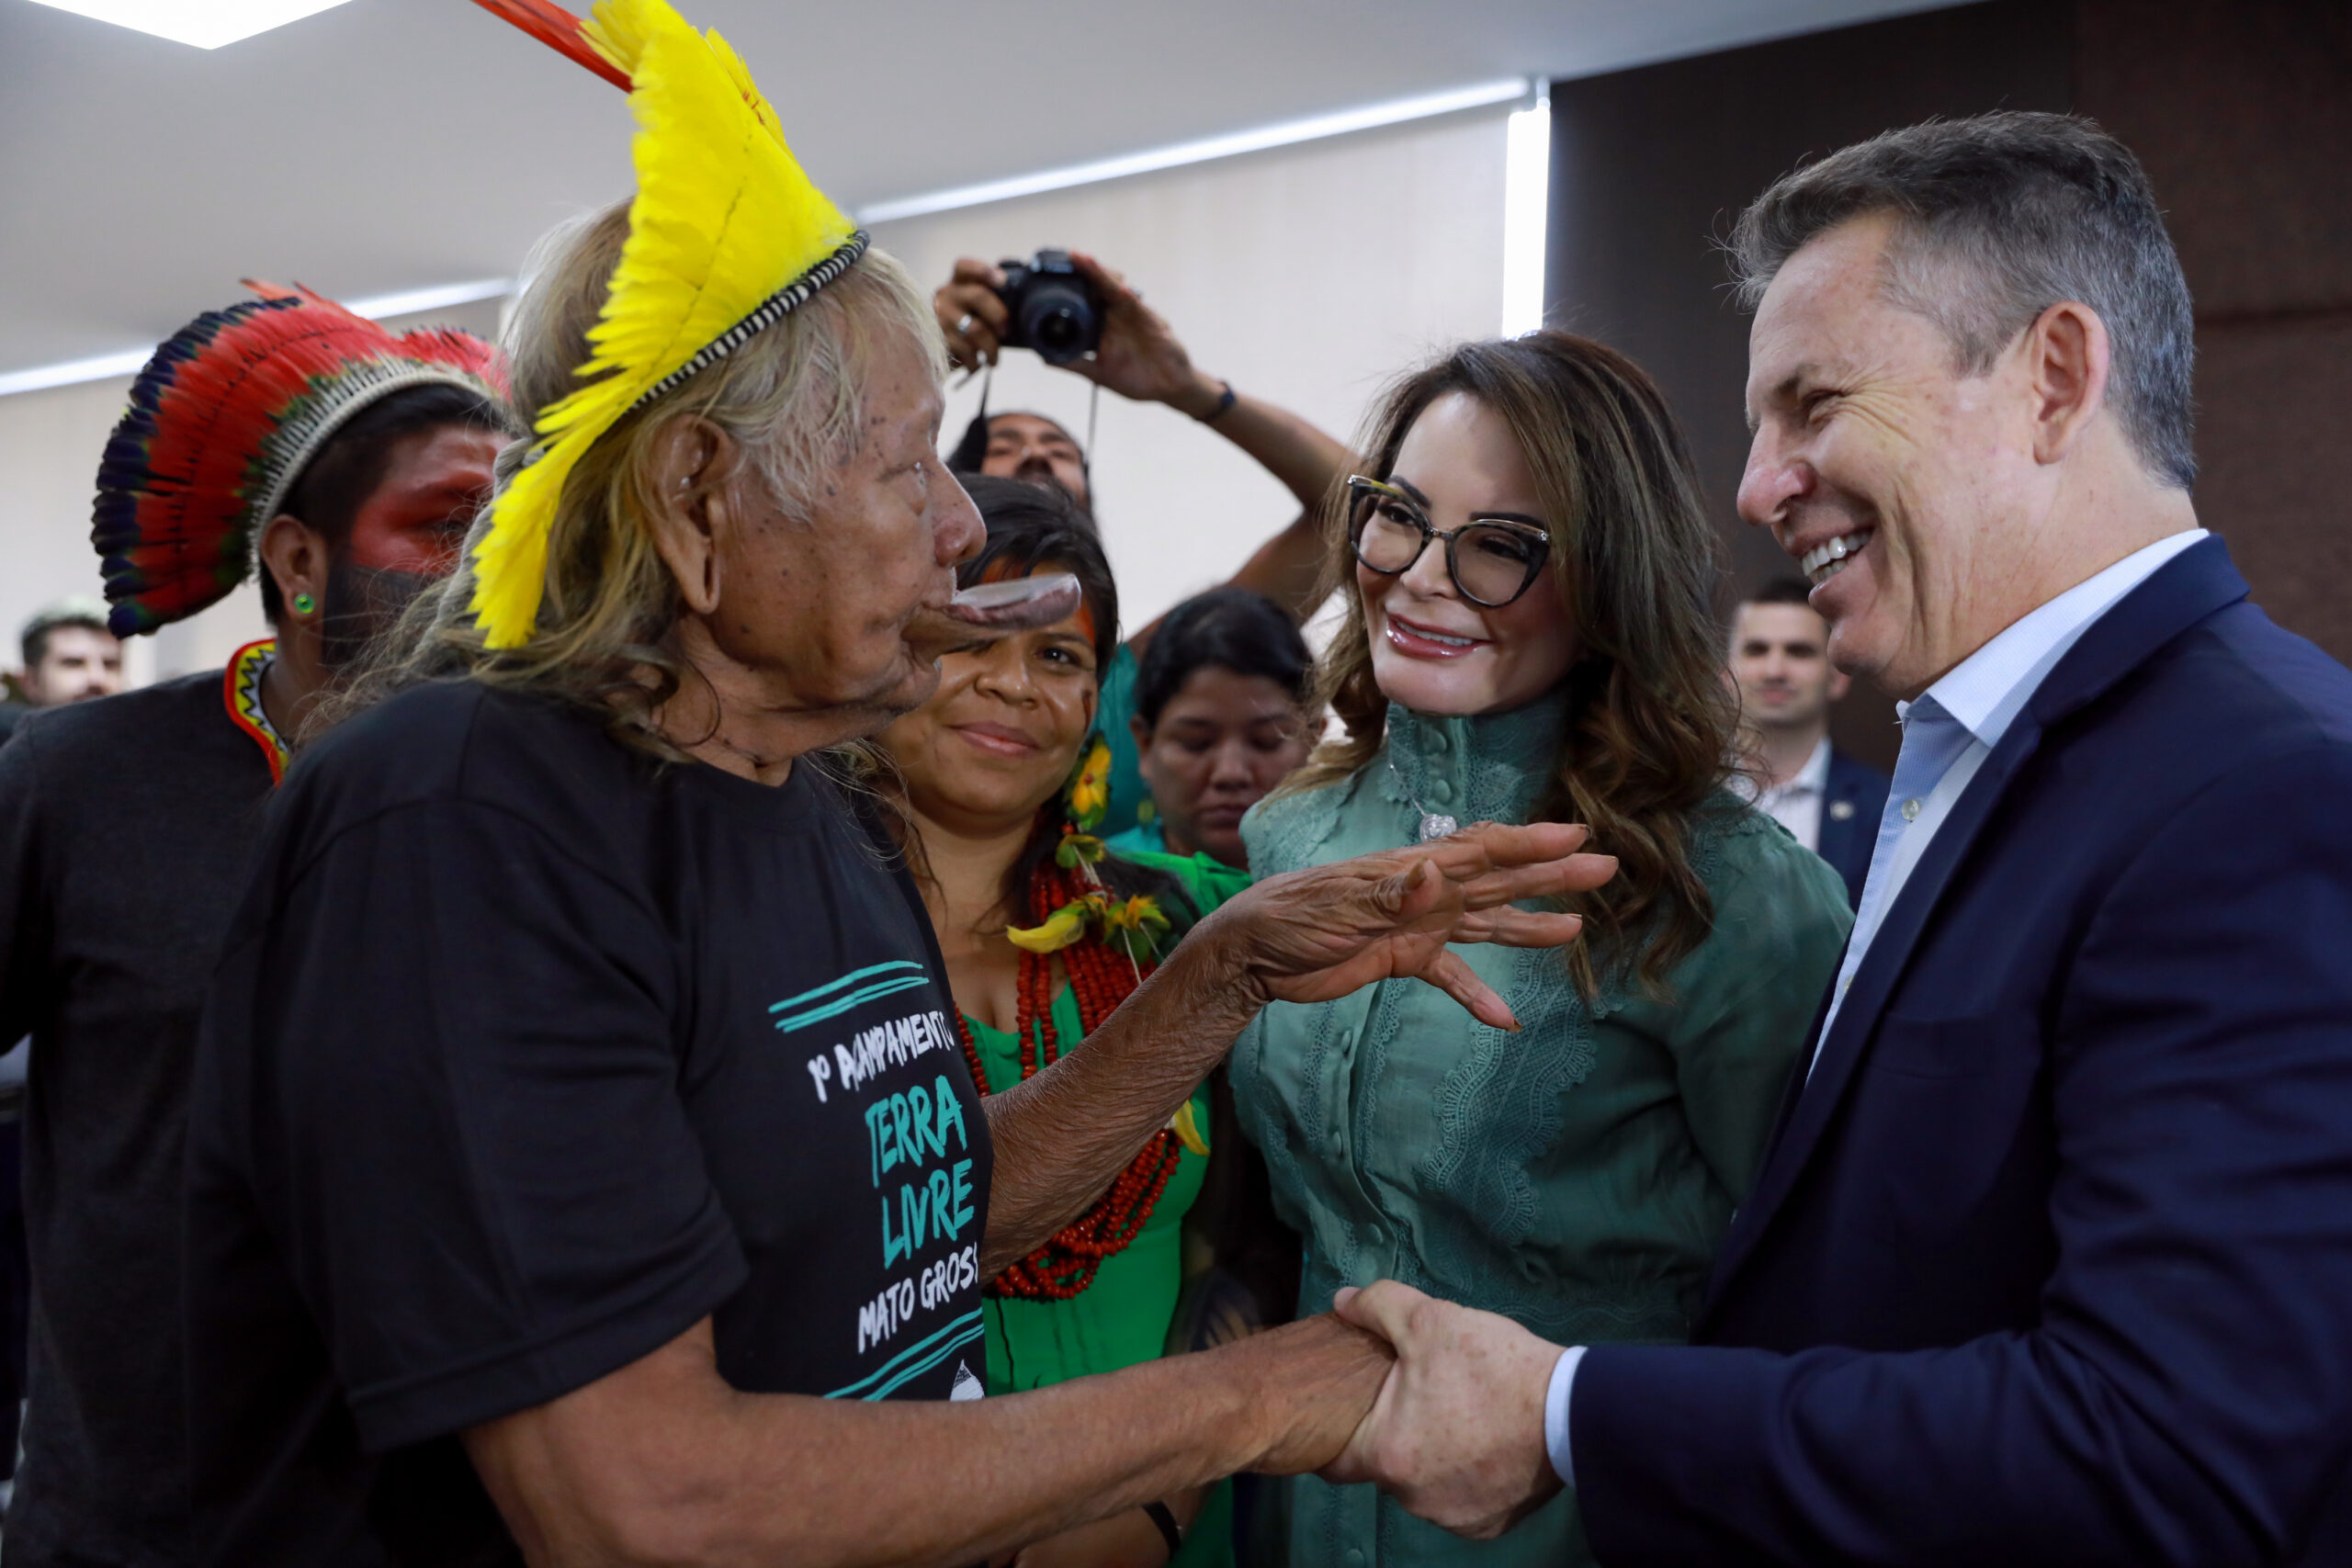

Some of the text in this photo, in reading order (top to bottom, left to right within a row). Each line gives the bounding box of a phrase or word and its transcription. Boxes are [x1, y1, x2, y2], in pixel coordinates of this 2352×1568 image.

[865, 1075, 966, 1189] TERRA
[882, 1158, 974, 1269] LIVRE
[858, 1278, 915, 1355] MATO
